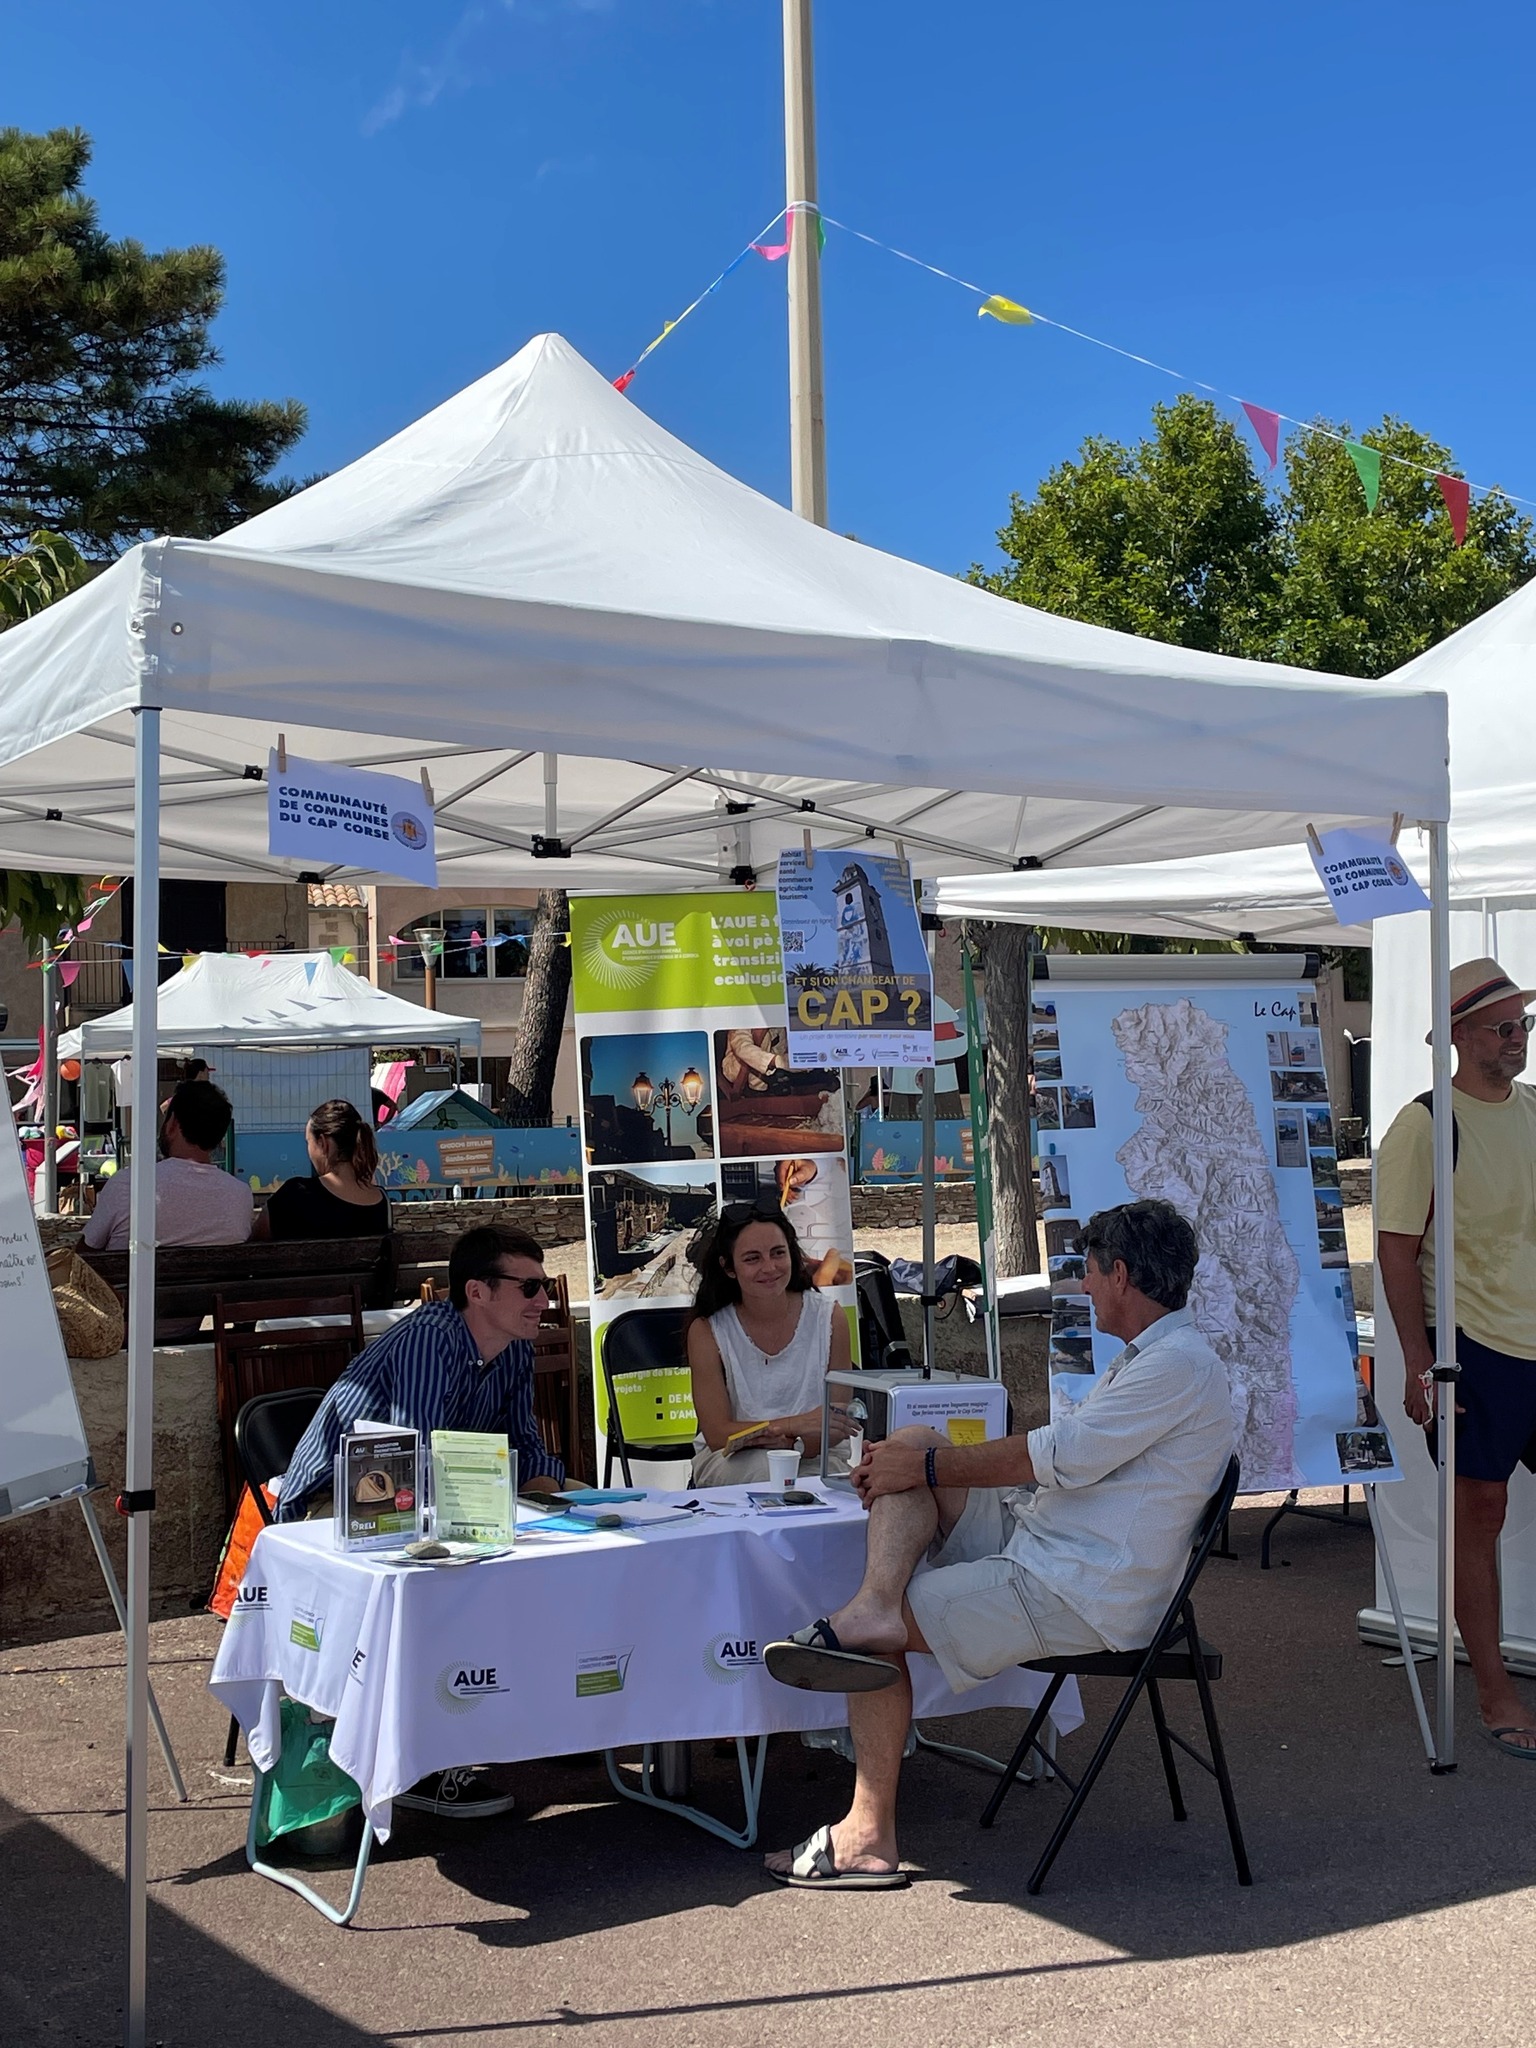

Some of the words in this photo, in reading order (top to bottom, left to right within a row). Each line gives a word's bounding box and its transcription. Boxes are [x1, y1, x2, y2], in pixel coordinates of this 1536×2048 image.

[279, 786, 388, 815] COMMUNAUTÉ
[279, 799, 298, 810] DE
[304, 803, 388, 827] COMMUNES
[279, 812, 300, 823] DU
[308, 816, 338, 829] CAP
[343, 822, 390, 841] CORSE
[1328, 875, 1343, 886] DE
[1333, 886, 1348, 897] DU
[1352, 880, 1370, 892] CAP
[1372, 878, 1393, 888] CORSE
[760, 914, 770, 928] à
[612, 922, 676, 948] AUE
[712, 934, 722, 948] à
[725, 933, 750, 947] voi
[753, 932, 774, 949] pè
[713, 951, 781, 967] transizi
[794, 977, 807, 986] ET
[810, 976, 820, 986] SI
[822, 976, 838, 986] ON
[841, 975, 900, 986] CHANGEAIT
[902, 976, 915, 986] DE
[797, 989, 889, 1027] CAP
[900, 989, 922, 1027] ?
[1254, 1001, 1266, 1017] Le
[1271, 1001, 1297, 1022] Cap
[669, 1393, 682, 1404] DE
[720, 1640, 757, 1658] AUE
[453, 1667, 497, 1687] AUE
